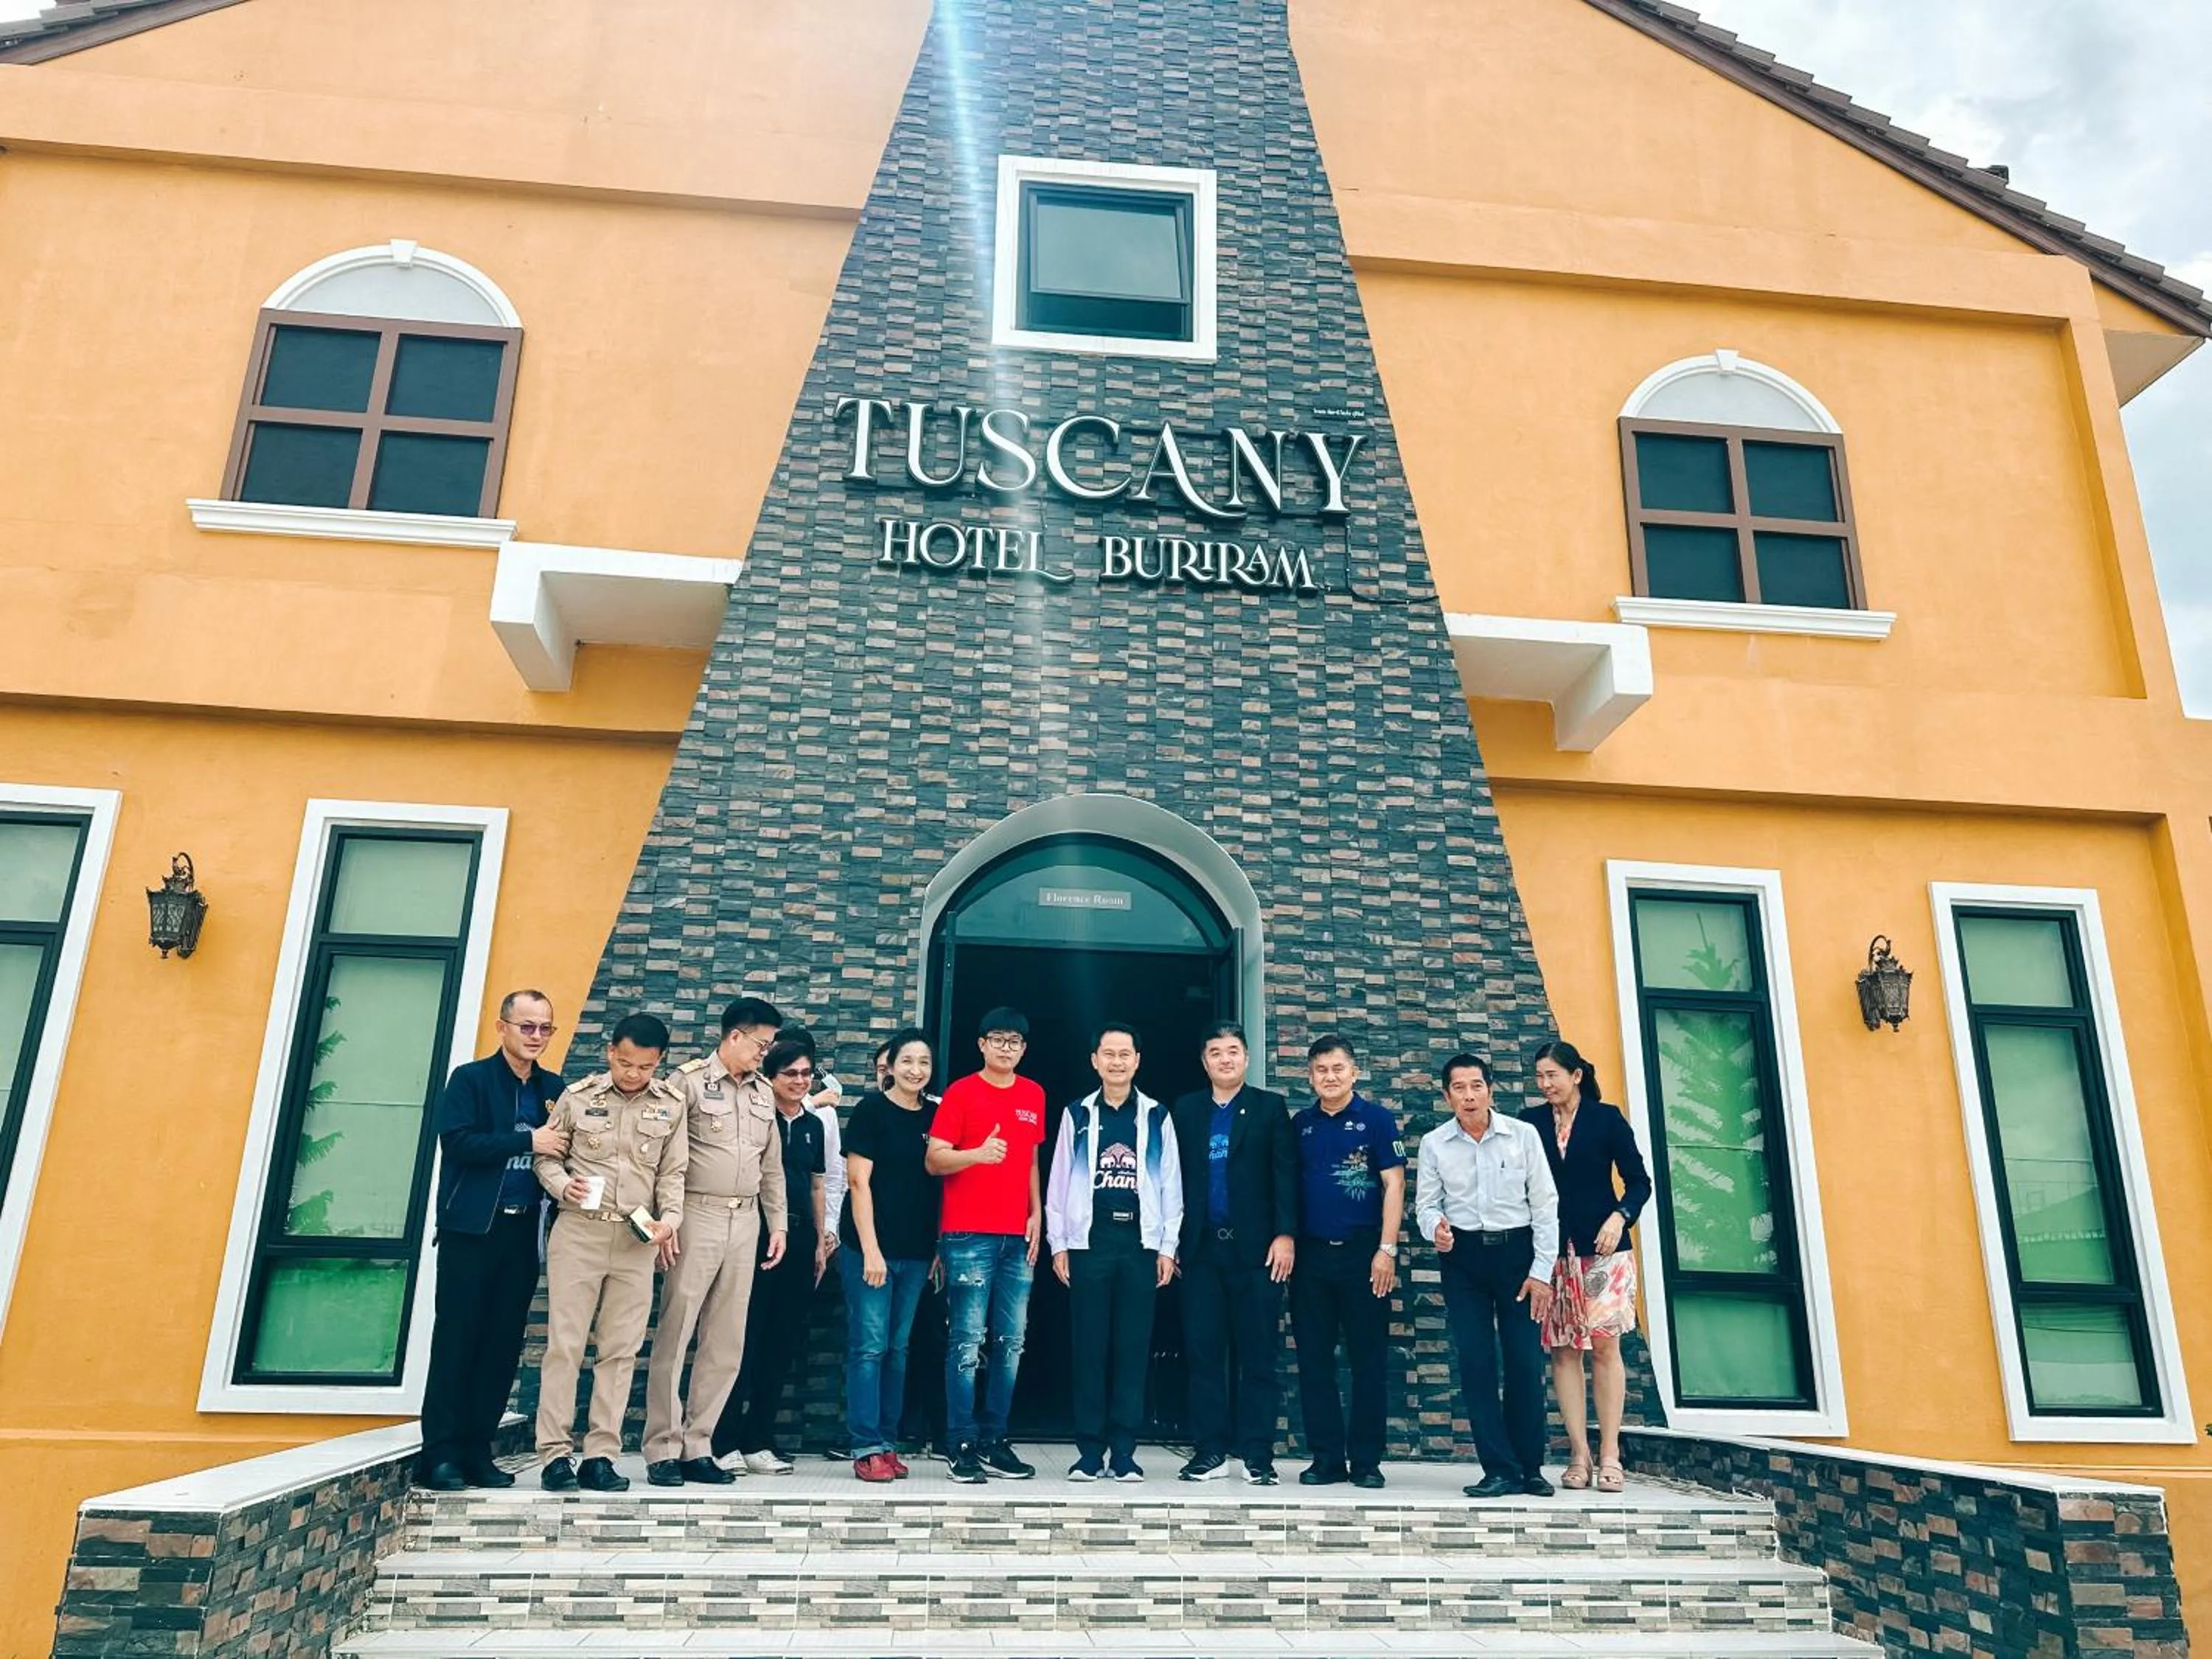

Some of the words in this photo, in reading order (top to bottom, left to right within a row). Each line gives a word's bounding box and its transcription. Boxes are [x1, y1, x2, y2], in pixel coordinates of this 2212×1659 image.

[836, 397, 1368, 518] TUSCANY
[880, 519, 1075, 583] HOTEL
[1102, 535, 1317, 588] BURIRAM
[1046, 892, 1090, 904] Florence
[1093, 894, 1124, 906] Room
[1093, 1170, 1138, 1194] Chan
